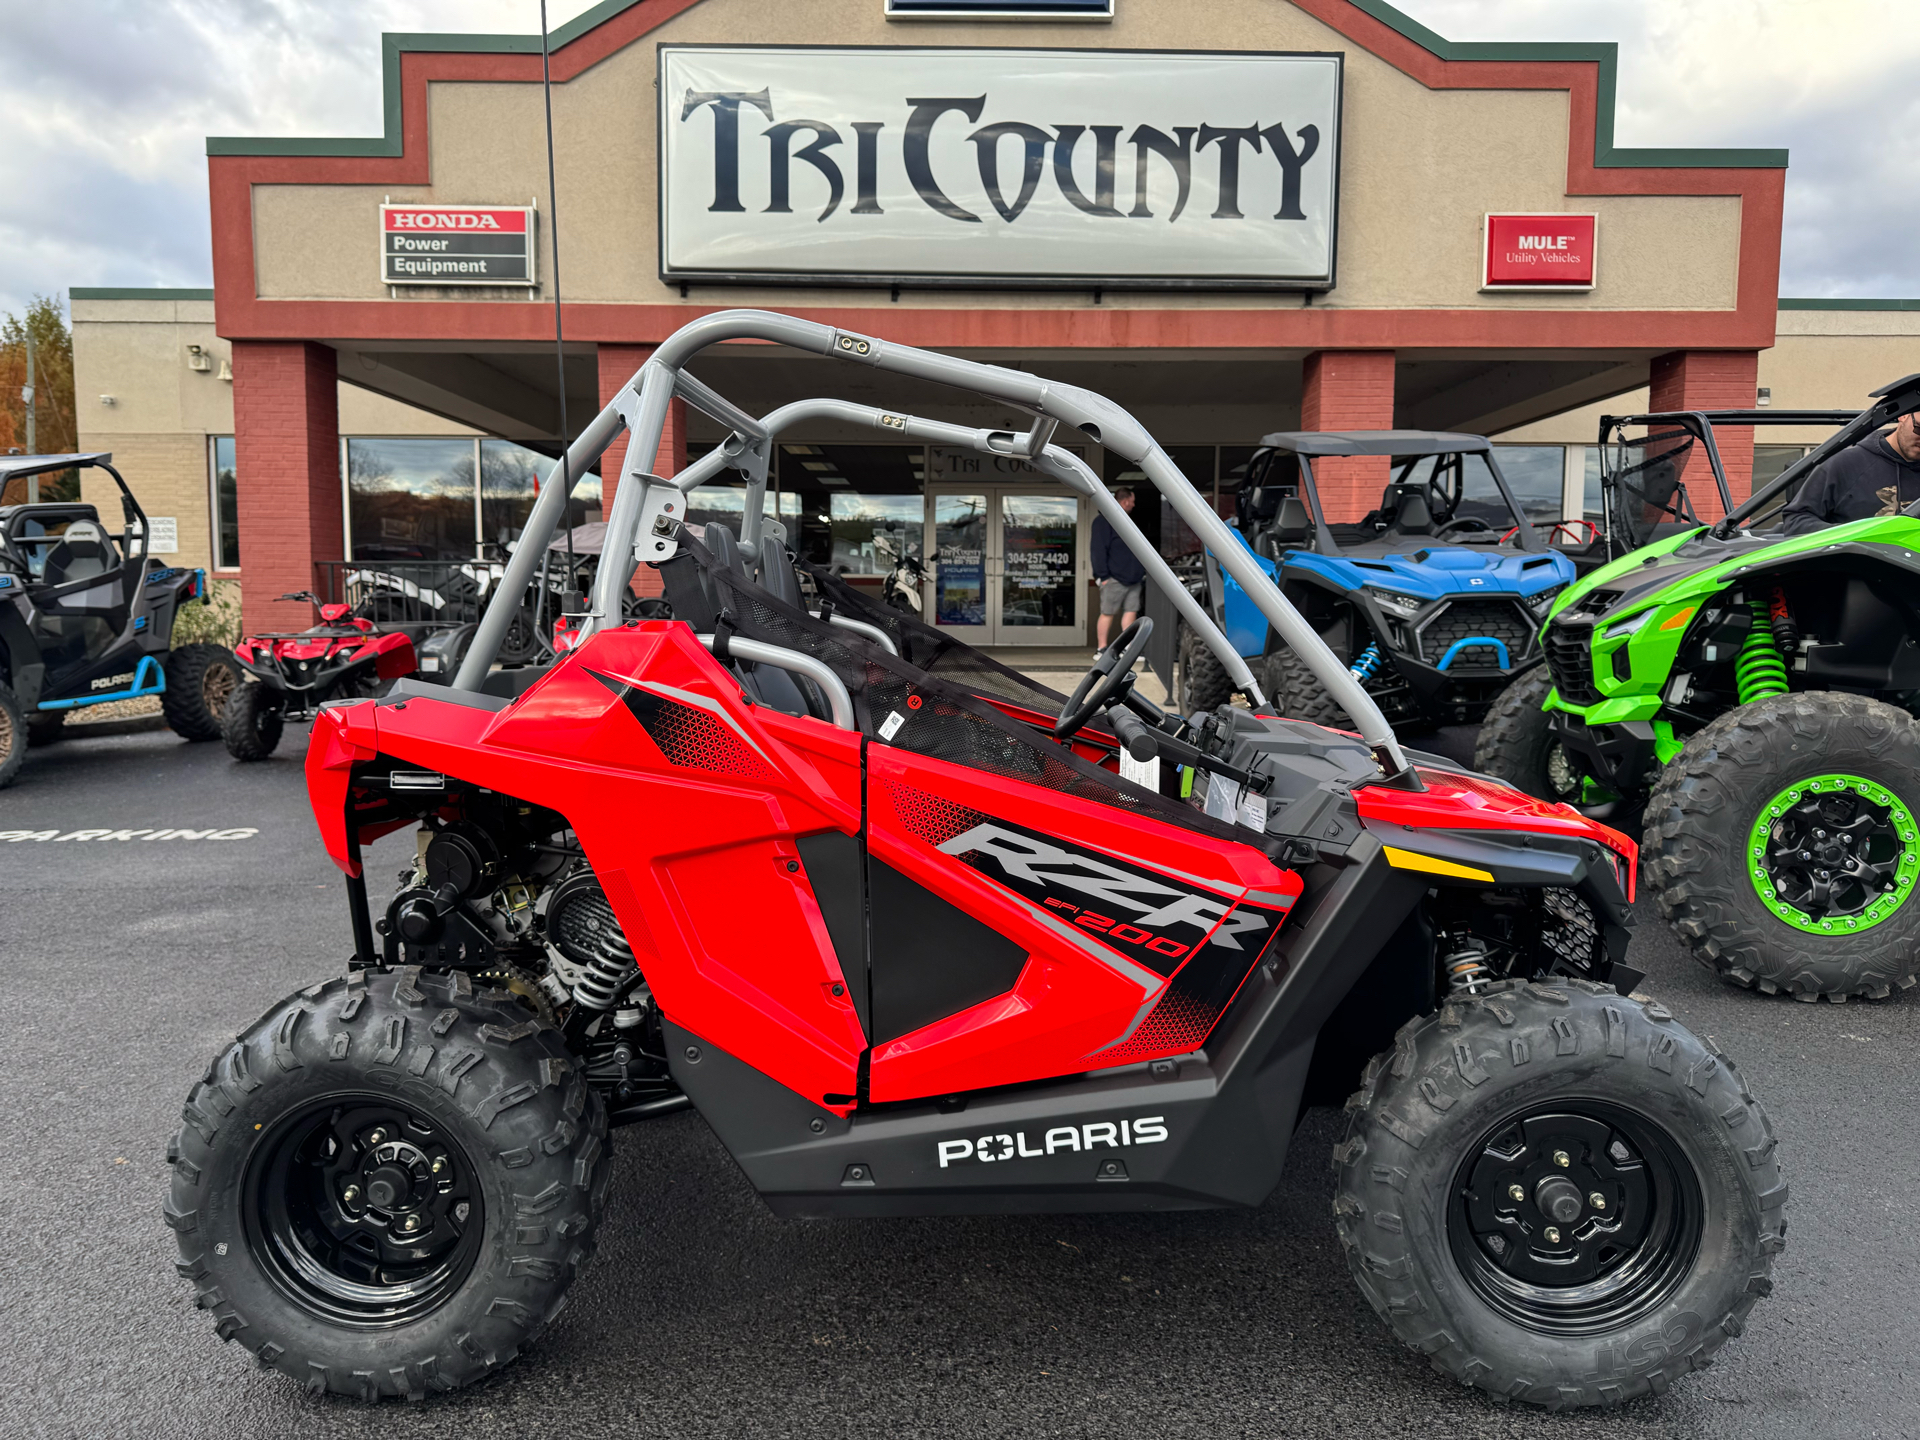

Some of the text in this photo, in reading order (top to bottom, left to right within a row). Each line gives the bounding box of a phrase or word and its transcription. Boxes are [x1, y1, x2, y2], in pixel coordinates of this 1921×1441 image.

[393, 213, 500, 229] HONDA
[393, 236, 449, 250] Power
[394, 257, 487, 275] Equipment
[1506, 252, 1581, 265] Utility Vehicles
[1007, 552, 1069, 565] 304-257-4420
[935, 822, 1270, 951] RZR
[1043, 896, 1191, 958] EFI 200
[937, 1116, 1169, 1168] POLARIS
[1584, 1310, 1703, 1384] CST
